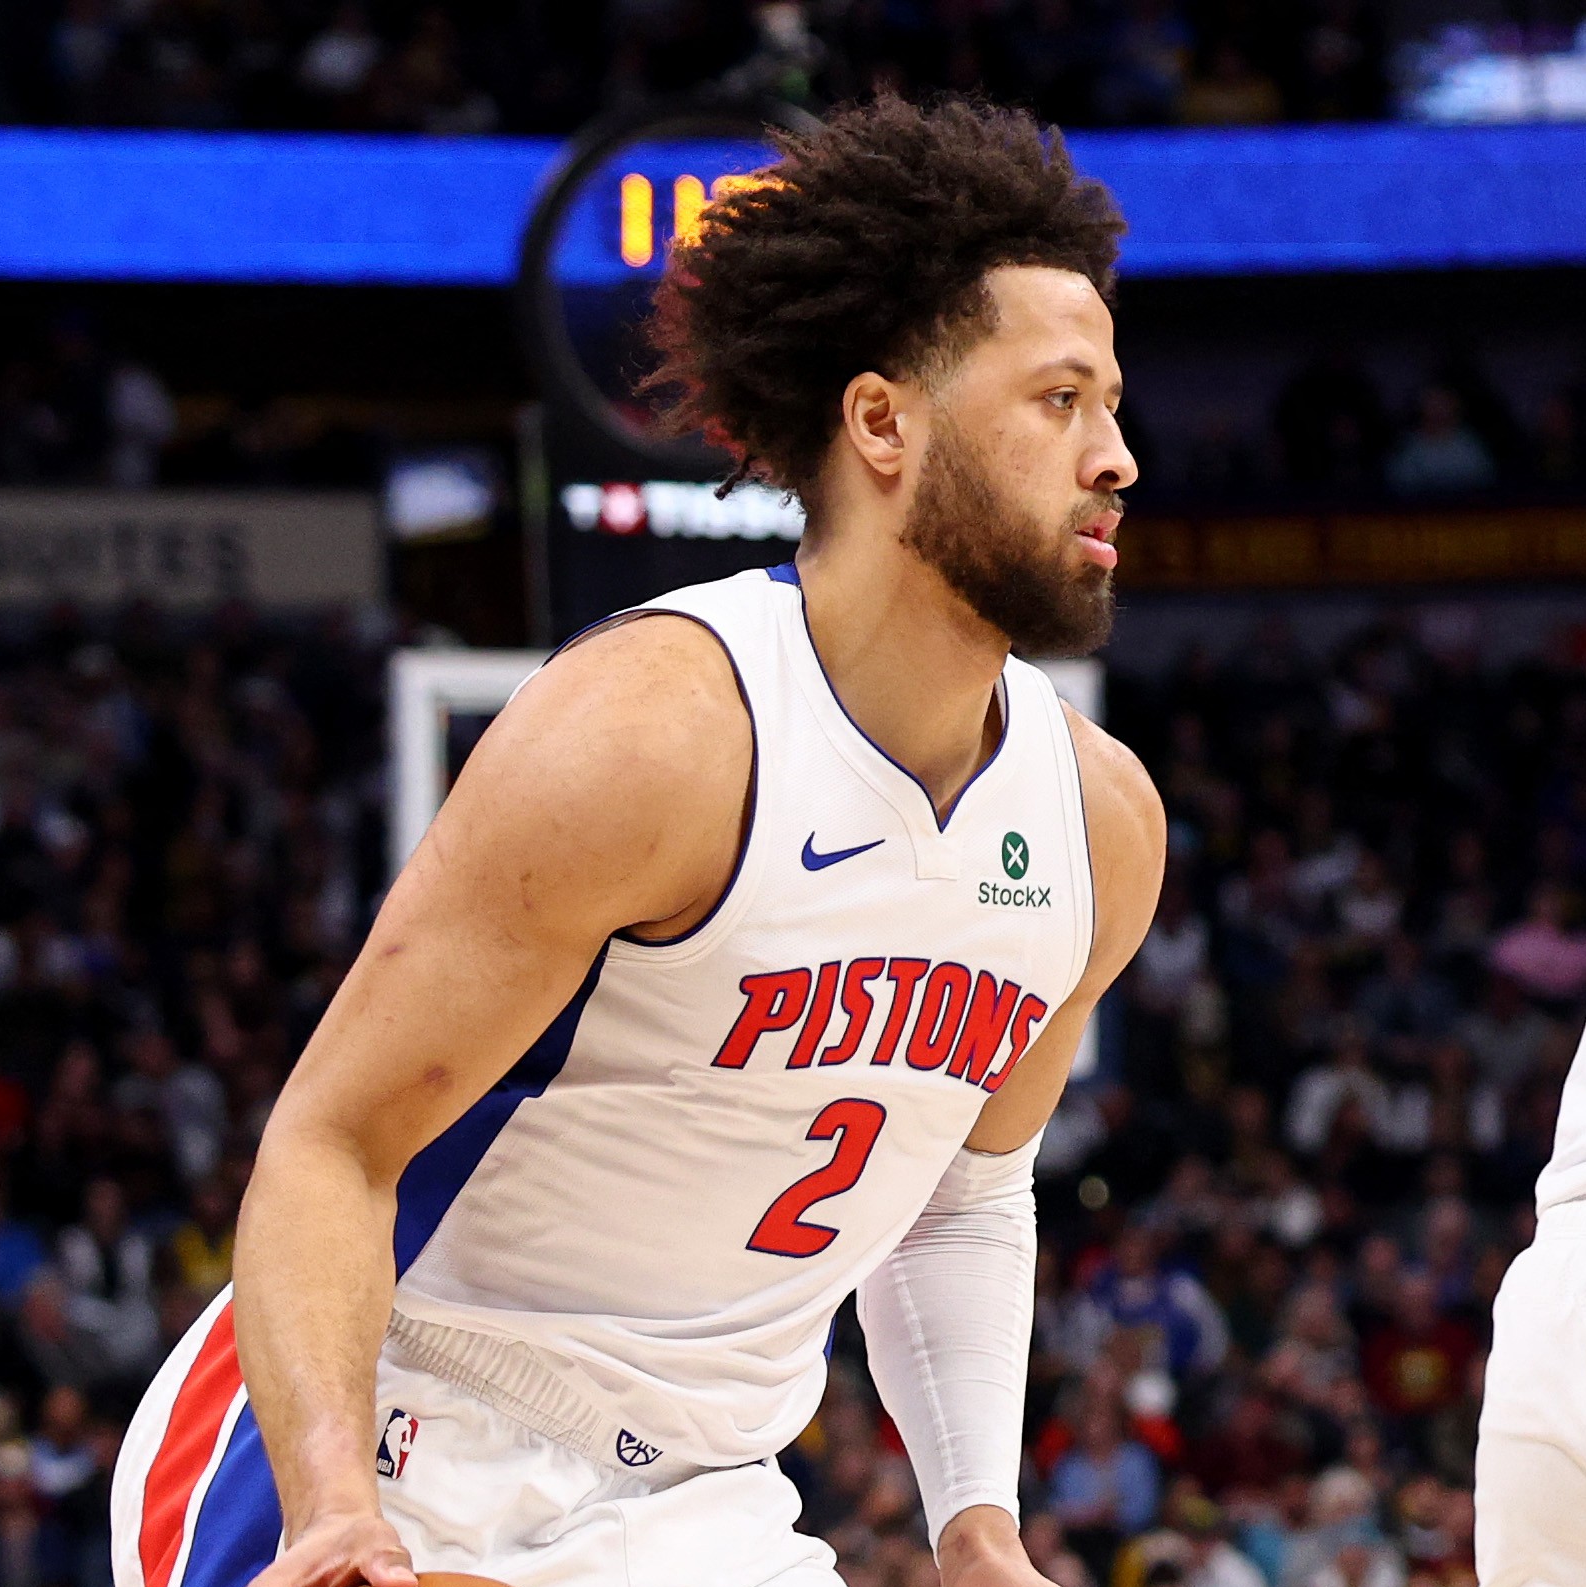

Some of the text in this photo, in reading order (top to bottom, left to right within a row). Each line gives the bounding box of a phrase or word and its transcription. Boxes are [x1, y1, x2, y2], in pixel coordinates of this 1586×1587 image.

[978, 881, 1052, 909] StockX
[710, 957, 1049, 1094] PISTONS
[745, 1097, 888, 1259] 2
